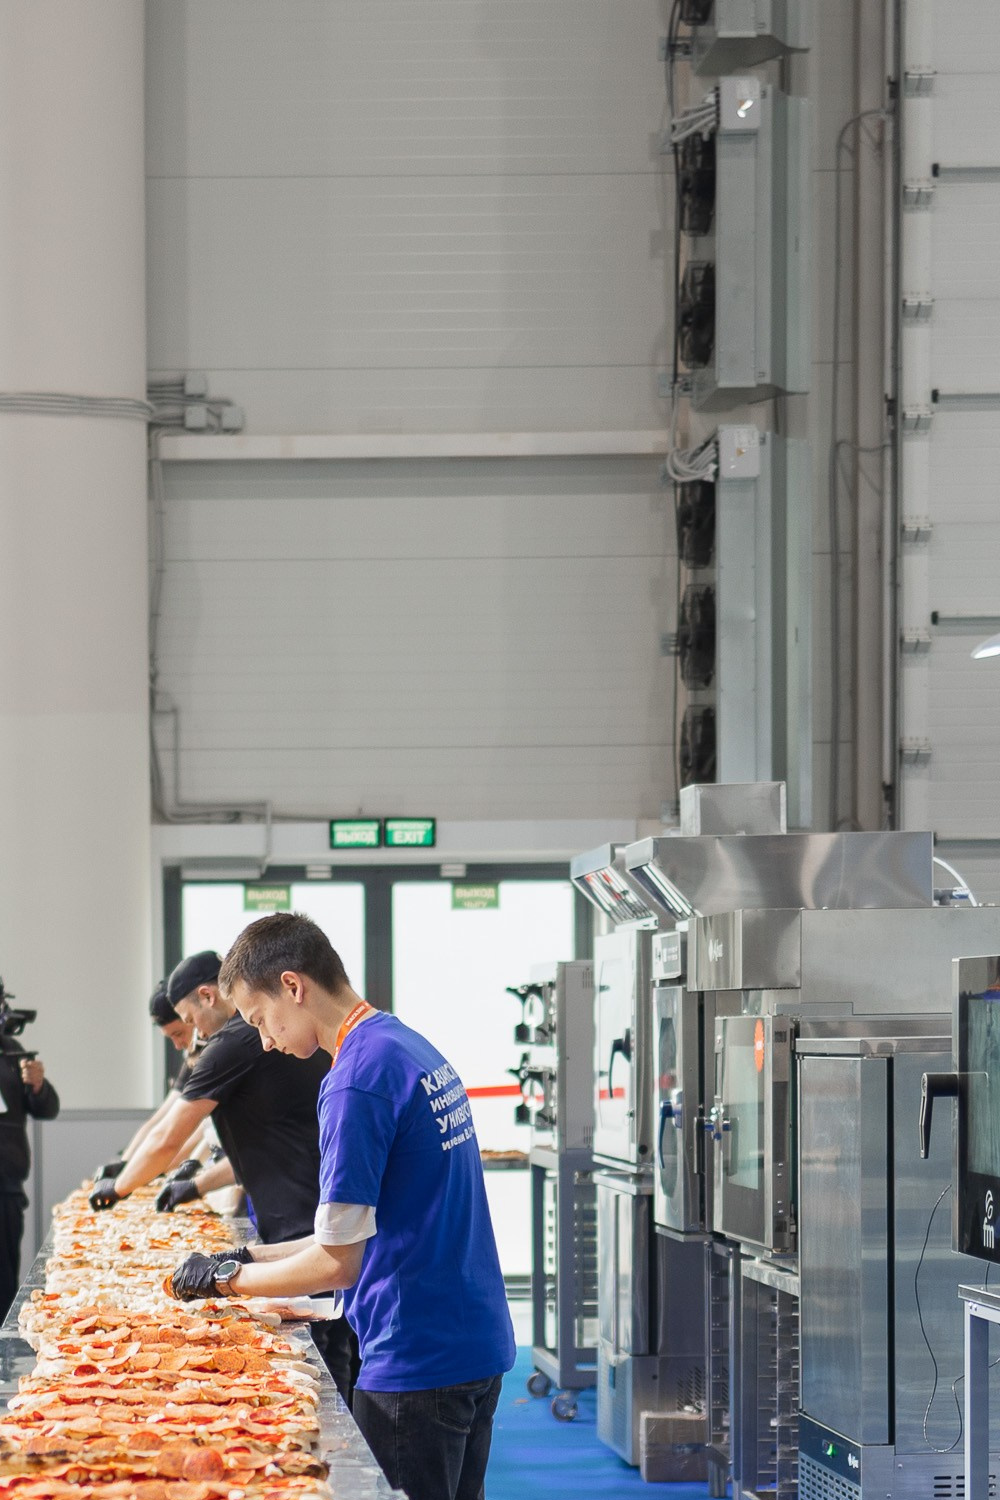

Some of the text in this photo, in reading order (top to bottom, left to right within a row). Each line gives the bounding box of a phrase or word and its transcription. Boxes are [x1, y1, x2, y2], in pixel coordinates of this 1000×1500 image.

[336, 831, 377, 845] ВЫХОД
[393, 830, 426, 844] EXIT
[247, 889, 287, 901] ВЫХОД
[455, 887, 496, 899] ВЫХОД
[982, 1217, 995, 1249] fm
